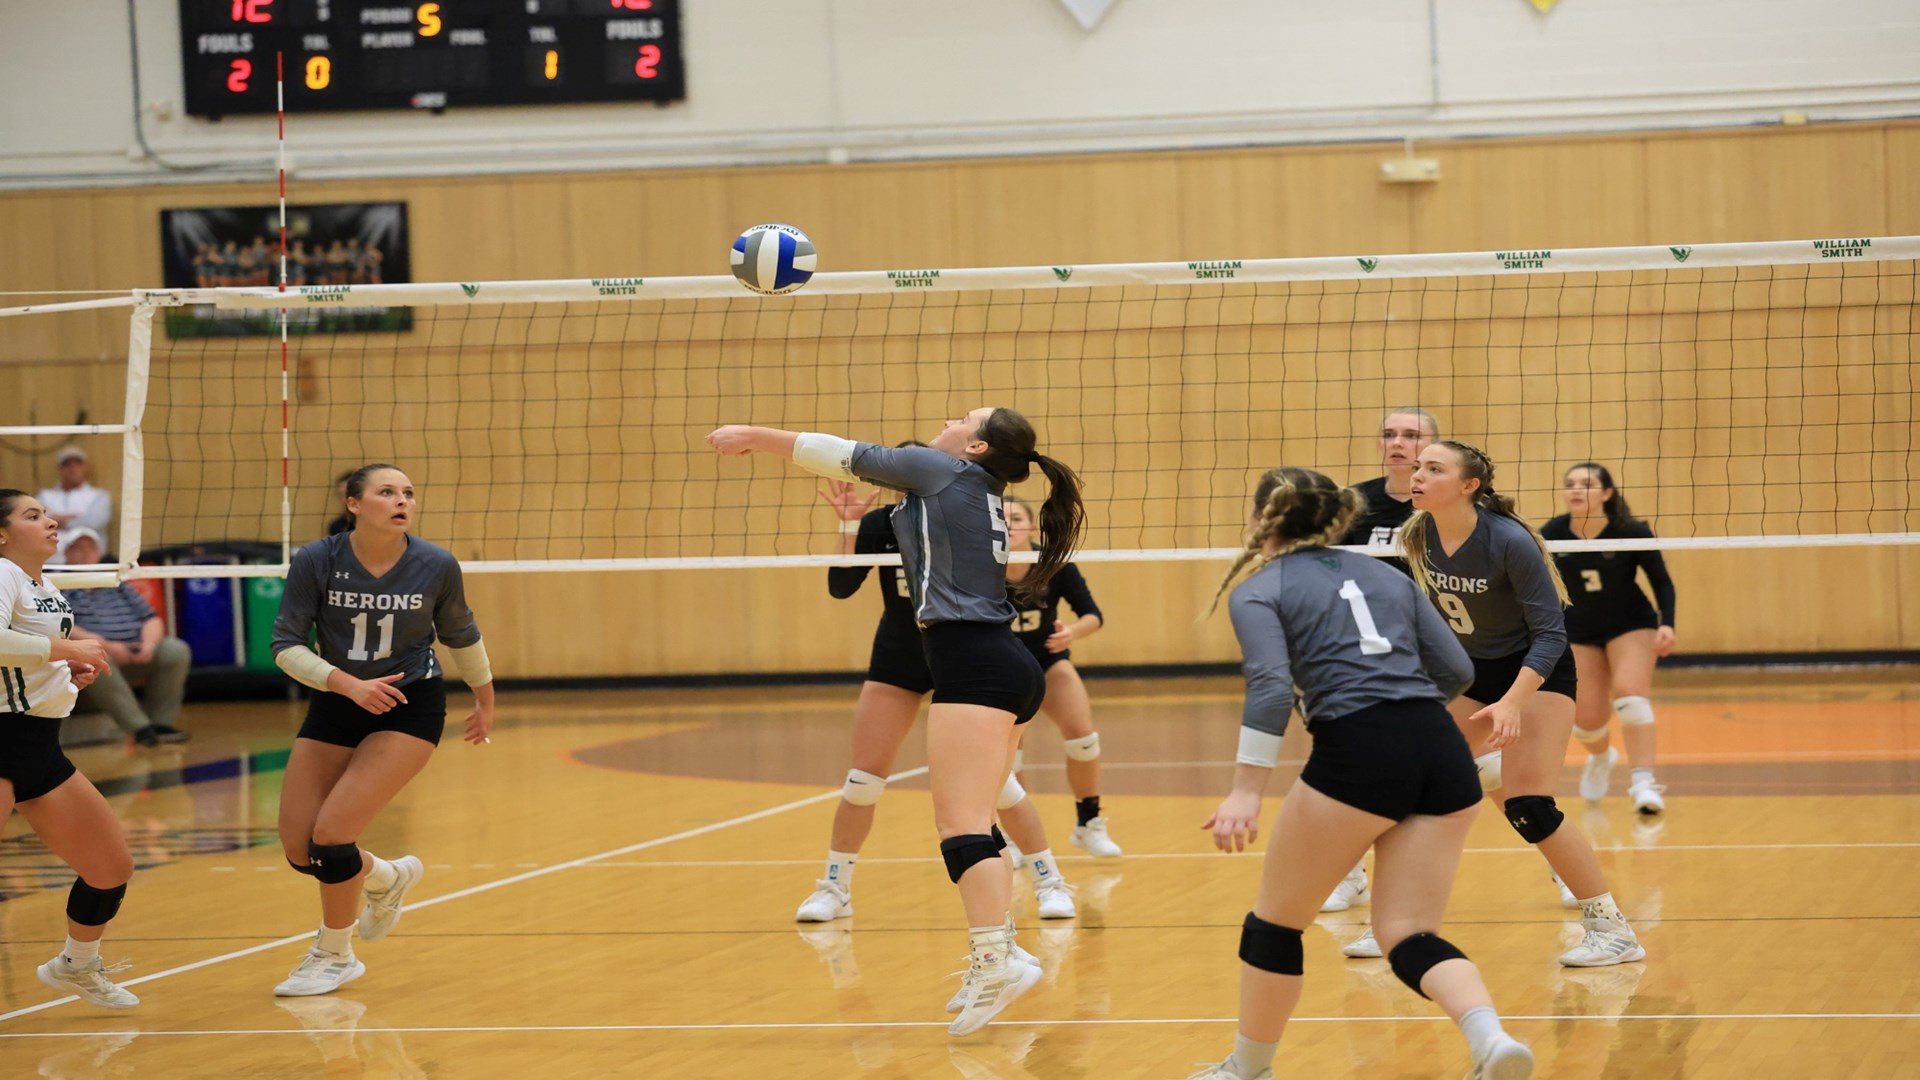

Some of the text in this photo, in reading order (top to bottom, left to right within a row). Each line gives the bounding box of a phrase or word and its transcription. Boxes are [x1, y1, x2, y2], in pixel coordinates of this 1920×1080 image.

[416, 2, 442, 37] 5
[606, 18, 664, 40] FOULS
[198, 33, 254, 54] FOULS
[361, 31, 414, 48] PLAYER
[544, 49, 559, 80] 1
[635, 44, 662, 78] 2
[227, 58, 252, 92] 2
[305, 55, 331, 90] 0
[1813, 239, 1871, 249] WILLIAM
[1821, 248, 1863, 258] SMITH
[1496, 251, 1552, 260] WILLIAM
[1504, 260, 1543, 269] SMITH
[887, 270, 940, 279] WILLIAM
[1188, 261, 1242, 270] WILLIAM
[1196, 270, 1235, 279] SMITH
[300, 285, 351, 294] WILLIAM
[591, 278, 644, 287] WILLIAM
[599, 286, 637, 295] SMITH
[895, 279, 933, 288] SMITH
[307, 294, 344, 303] SMITH
[986, 493, 1010, 565] 5
[1580, 569, 1603, 592] 3
[328, 590, 423, 610] HERONS
[1338, 579, 1393, 656] 1
[1437, 592, 1475, 635] 9
[347, 612, 395, 662] 11
